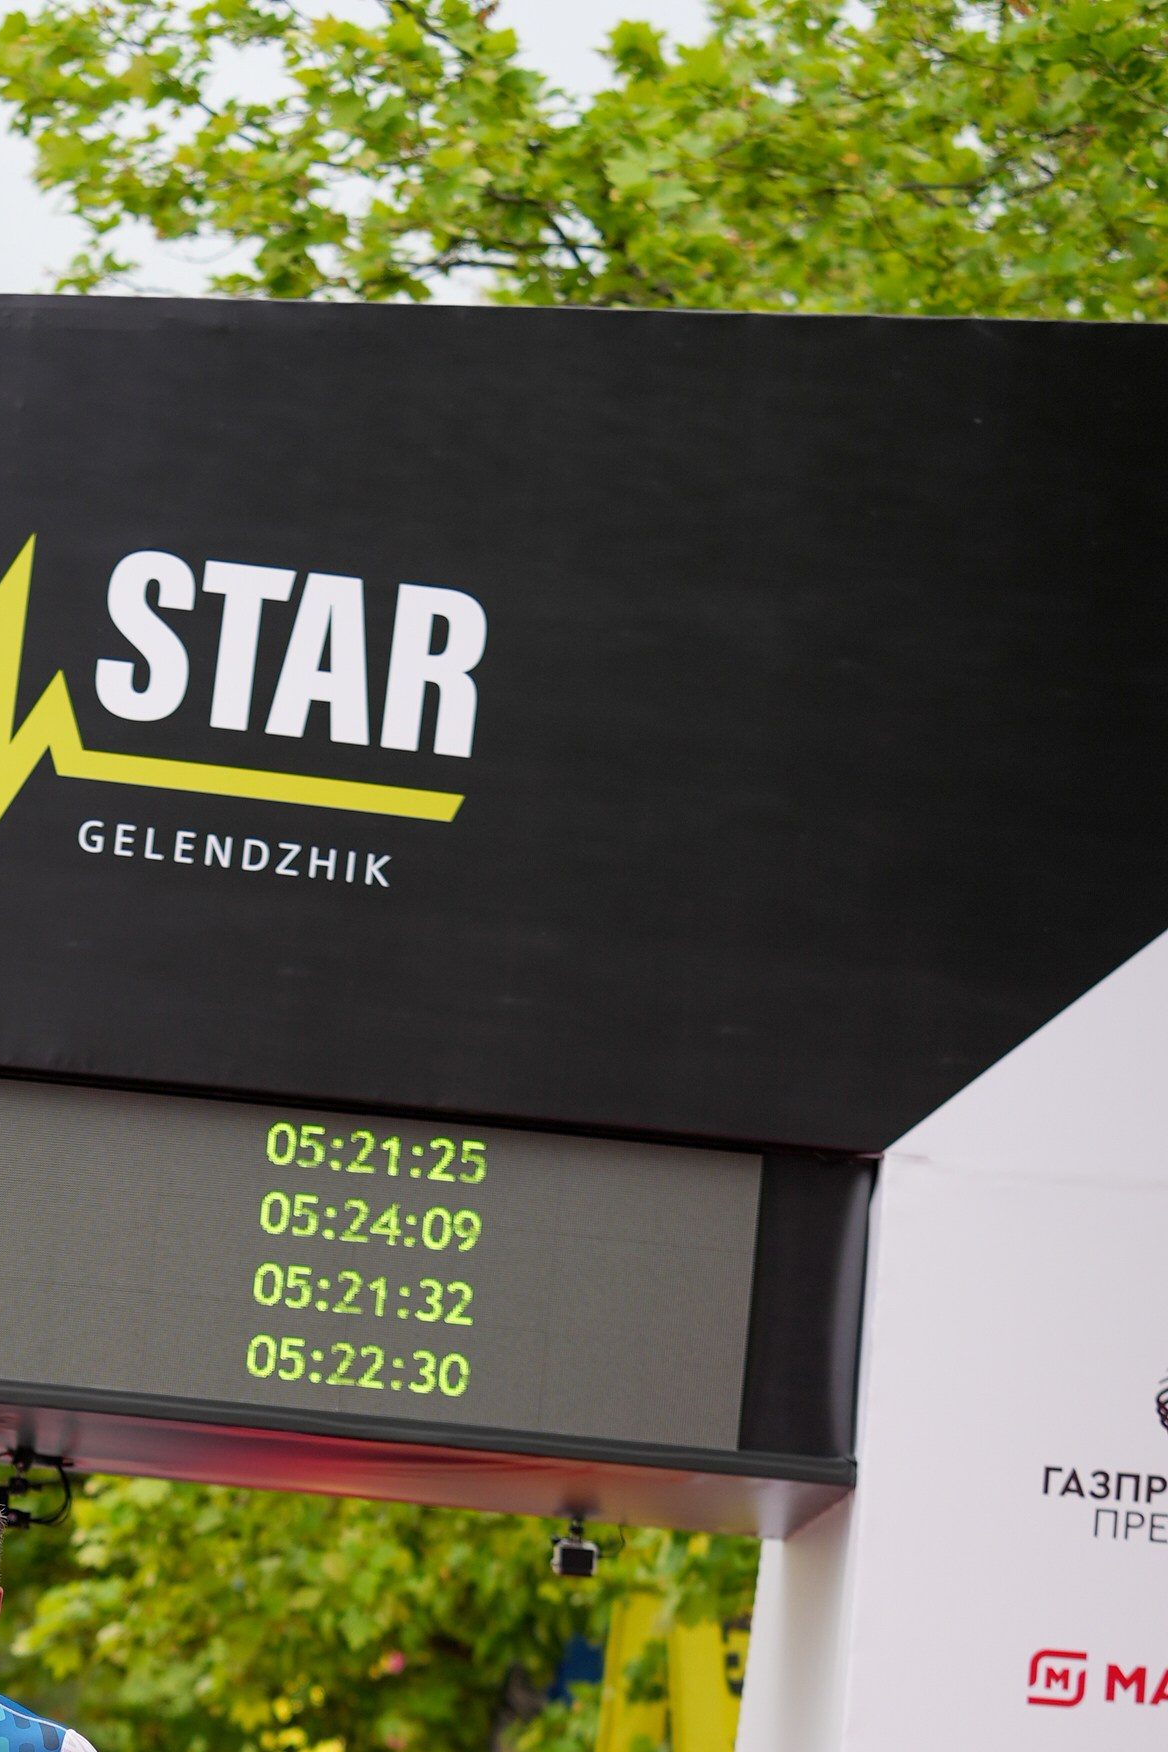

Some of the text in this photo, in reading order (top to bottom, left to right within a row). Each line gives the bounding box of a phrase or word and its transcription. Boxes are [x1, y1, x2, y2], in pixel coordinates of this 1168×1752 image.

[95, 551, 487, 757] STAR
[78, 820, 392, 887] GELENDZHIK
[265, 1121, 488, 1184] 05:21:25
[259, 1189, 483, 1252] 05:24:09
[252, 1261, 474, 1325] 05:21:32
[245, 1333, 471, 1397] 05:22:30
[1042, 1465, 1168, 1503] ГАЗПР
[1093, 1508, 1168, 1544] ПРЕ
